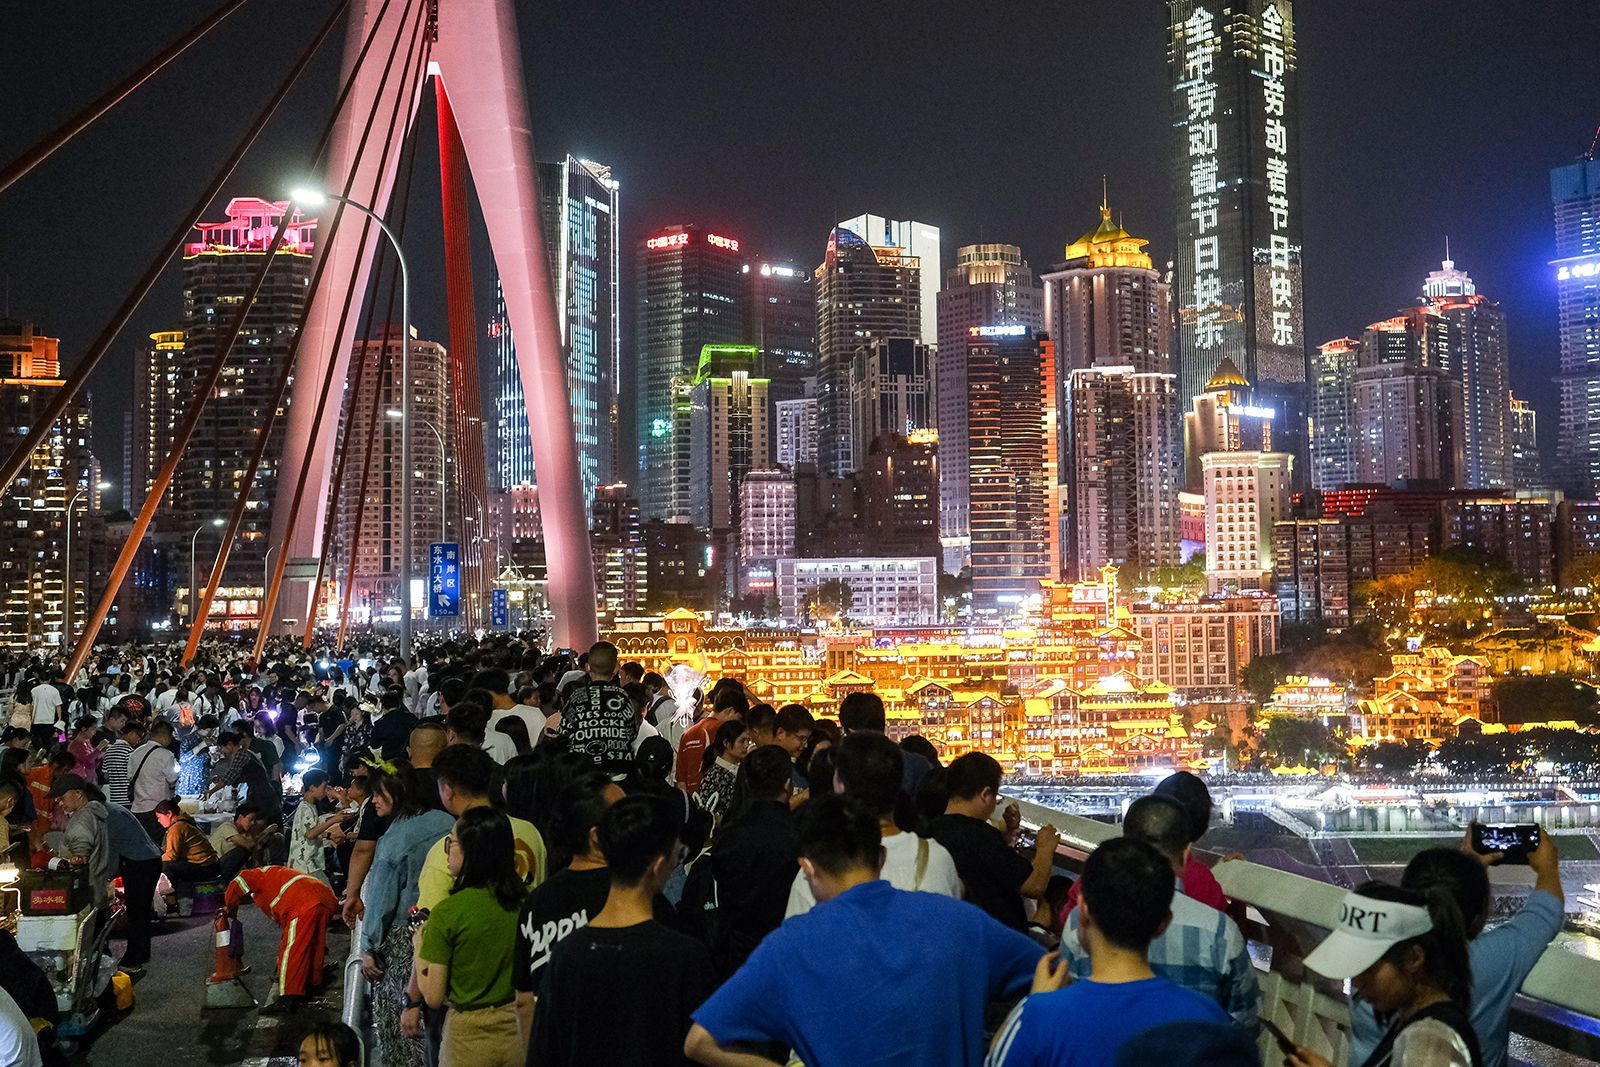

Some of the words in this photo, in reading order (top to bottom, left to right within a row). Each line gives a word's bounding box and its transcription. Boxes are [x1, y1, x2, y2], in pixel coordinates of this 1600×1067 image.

[1185, 6, 1223, 349] 全市劳动者节日快乐
[1262, 4, 1293, 345] 全市劳动者节日快乐
[647, 233, 689, 249] 中国平安
[707, 233, 739, 251] 中国平安
[433, 546, 442, 593] 东水门大桥
[446, 551, 455, 588] 南岸区
